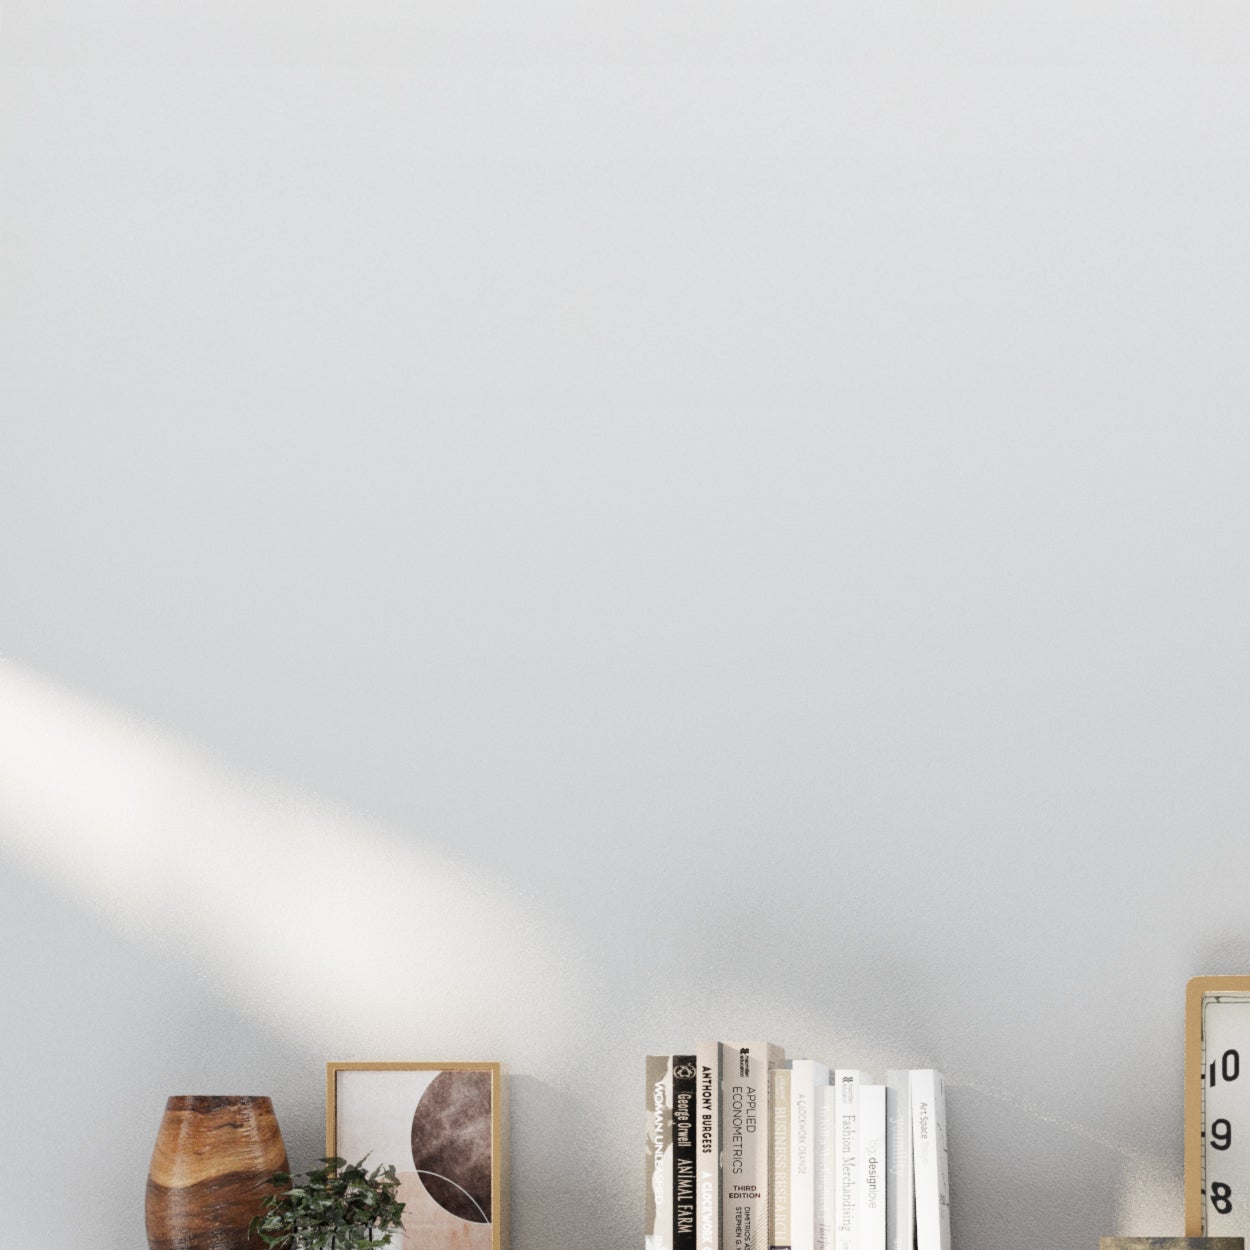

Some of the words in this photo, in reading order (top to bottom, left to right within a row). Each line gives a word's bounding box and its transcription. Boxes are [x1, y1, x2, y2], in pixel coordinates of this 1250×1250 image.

[701, 1065, 712, 1111] ANTHONY
[1209, 1049, 1240, 1088] 10
[654, 1080, 664, 1133] WOMAN
[674, 1093, 692, 1121] George
[746, 1086, 756, 1133] APPLIED
[677, 1122, 692, 1147] Orwell
[701, 1114, 712, 1154] BURGESS
[732, 1086, 743, 1175] ECONOMETRICS
[775, 1107, 785, 1169] BUSINESS
[842, 1114, 856, 1154] Fashion
[1210, 1118, 1231, 1151] 9
[702, 1181, 712, 1244] CLOCKWORK
[775, 1171, 785, 1241] RESEARCH
[839, 1156, 856, 1232] Merchandising
[1210, 1181, 1233, 1215] 8
[677, 1204, 693, 1234] FARM
